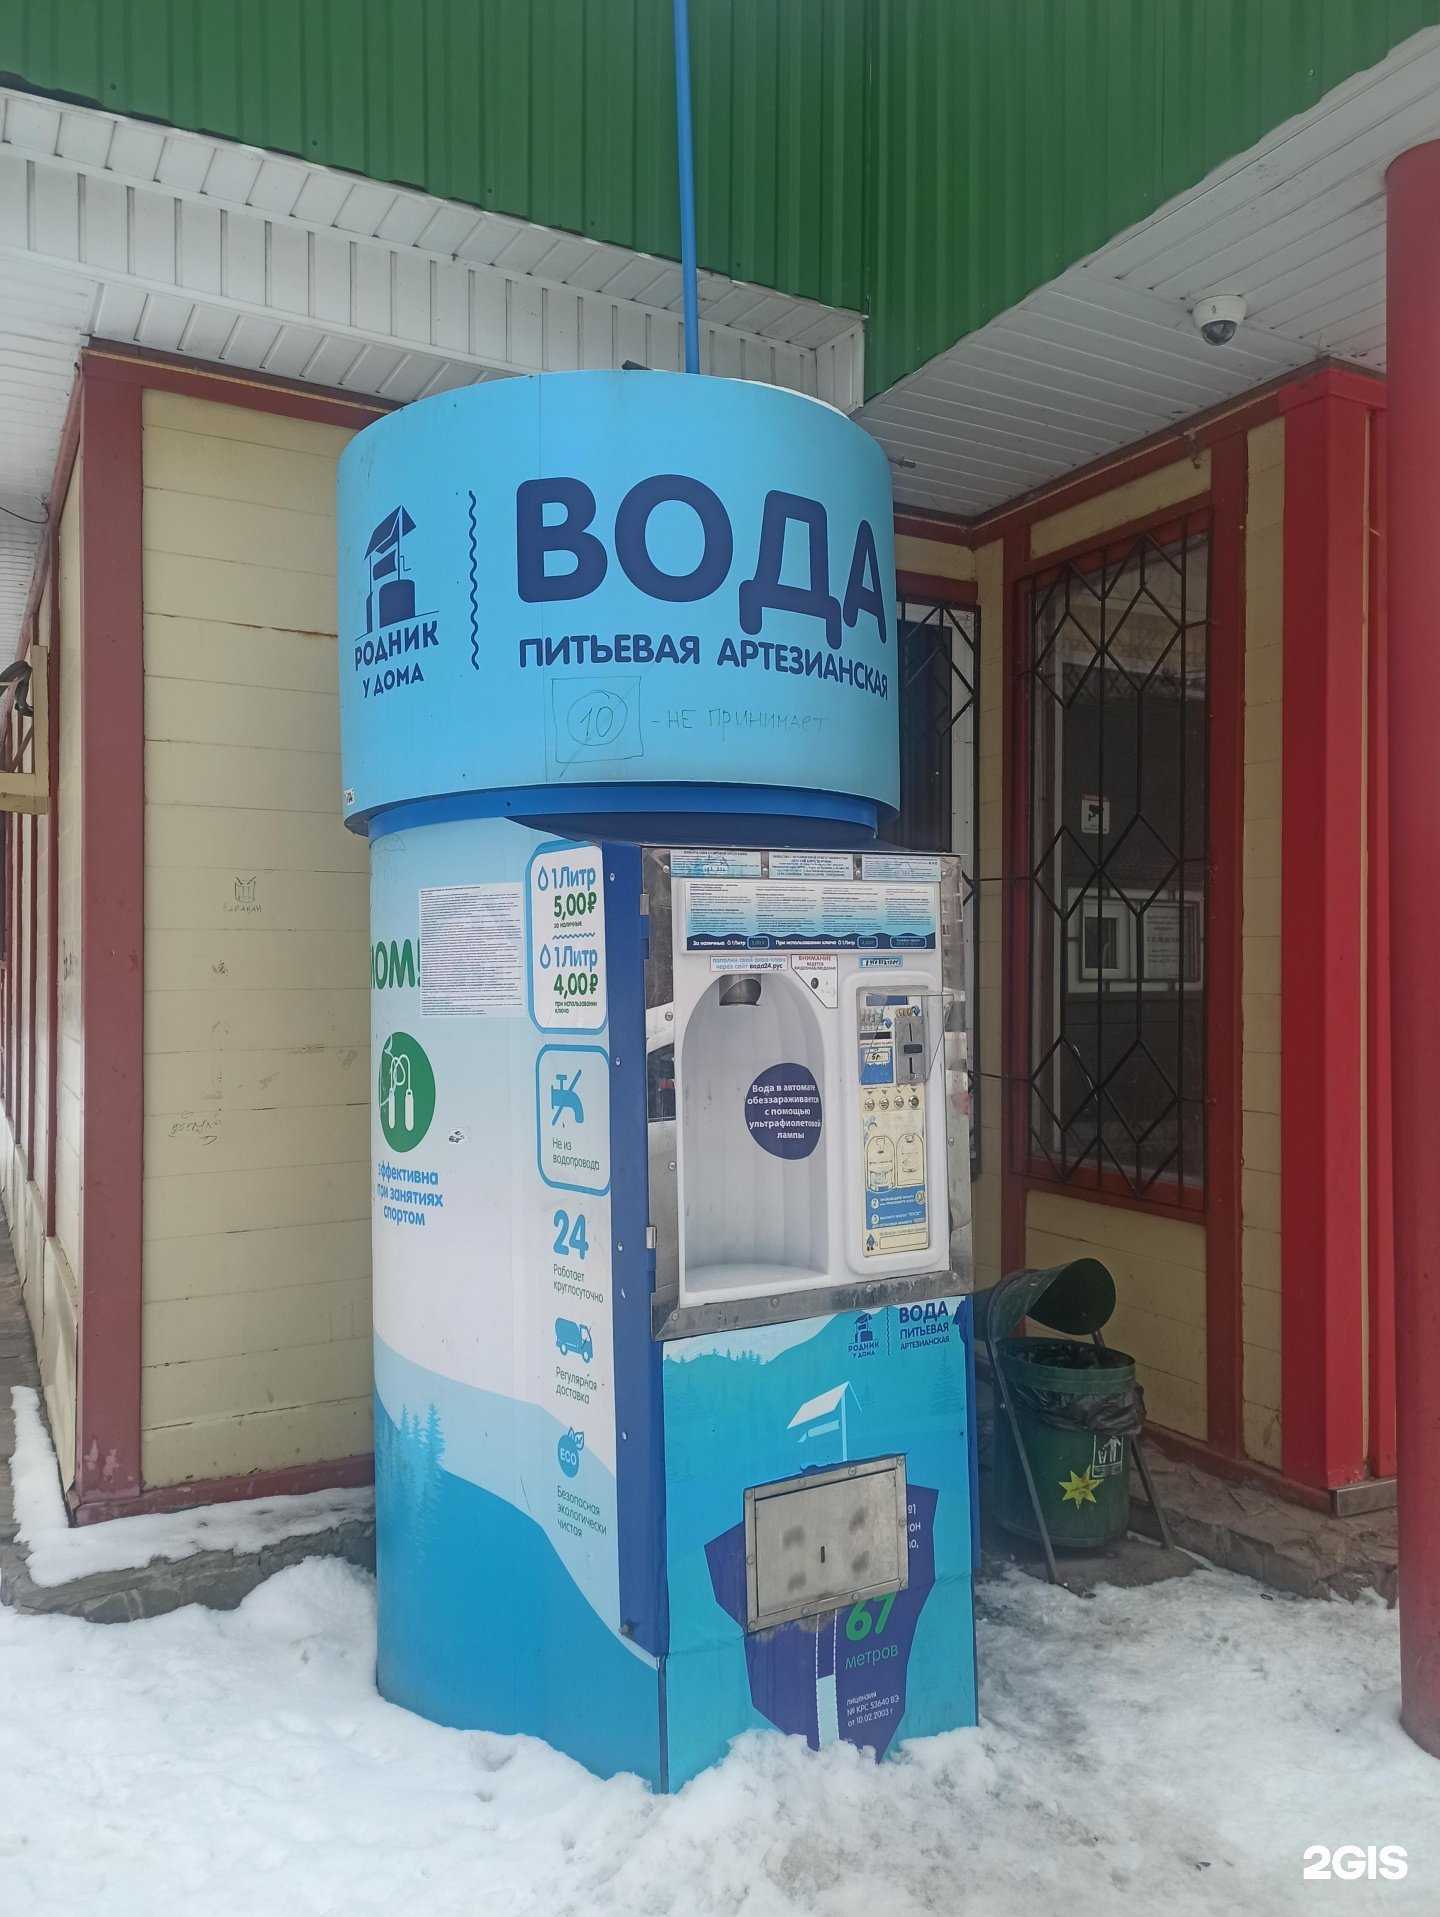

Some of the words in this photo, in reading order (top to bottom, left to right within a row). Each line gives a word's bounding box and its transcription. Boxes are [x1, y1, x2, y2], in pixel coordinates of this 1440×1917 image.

[516, 473, 887, 649] ВОДА
[355, 620, 439, 671] РОДНИК
[519, 633, 700, 668] ПИТЬЕВАЯ
[717, 637, 888, 700] АРТЕЗИАНСКАЯ
[363, 678, 371, 698] У
[374, 662, 424, 696] ДОМА
[668, 709, 697, 730] НЕ
[752, 1084, 775, 1094] Вода
[776, 1084, 782, 1092] в
[771, 1108, 811, 1117] помощью
[552, 1136, 563, 1150] Не
[564, 1140, 572, 1151] из
[777, 1131, 805, 1139] лампы
[552, 1154, 600, 1172] водопровода
[389, 1188, 444, 1208] занятиях
[383, 1205, 426, 1226] спортом
[553, 1209, 589, 1261] 24
[553, 1263, 585, 1282] Работает
[553, 1281, 604, 1304] круглосуточно
[899, 1300, 949, 1324] ВОДА
[900, 1322, 949, 1340] ПИТЬЕВАЯ
[848, 1341, 880, 1353] РОДНИК
[900, 1335, 950, 1350] АРТЕЗИАНСКАЯ
[555, 1366, 598, 1392] Регулярная
[555, 1384, 590, 1404] доставка
[560, 1448, 577, 1466] ECO
[557, 1485, 600, 1515] Безопасная
[557, 1519, 583, 1537] чистая
[846, 1590, 897, 1641] 67
[845, 1645, 899, 1671] метров
